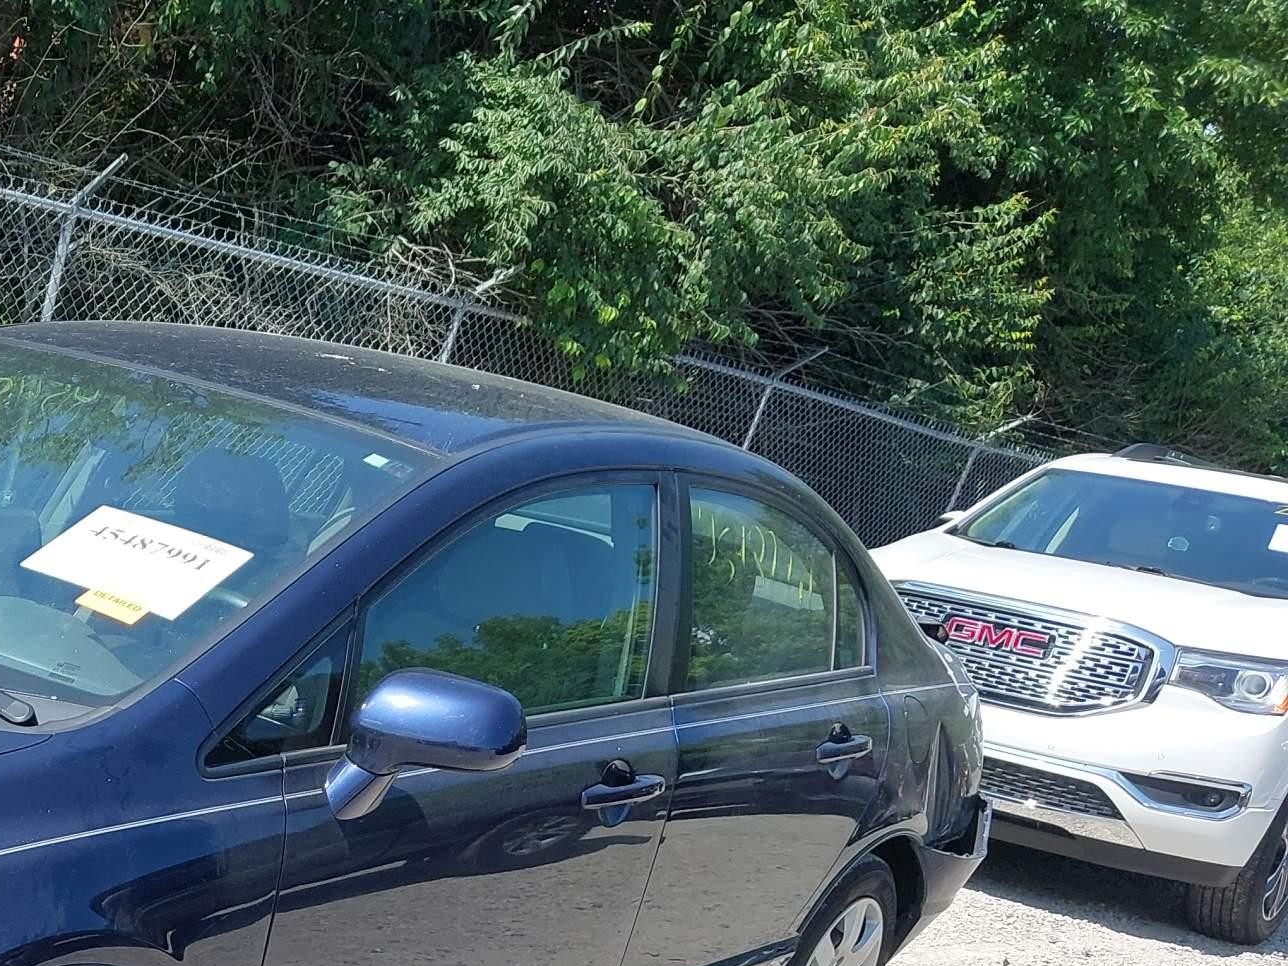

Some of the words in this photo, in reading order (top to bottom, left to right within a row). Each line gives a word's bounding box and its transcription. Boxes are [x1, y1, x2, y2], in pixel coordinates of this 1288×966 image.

[90, 526, 211, 570] 45487991
[93, 589, 143, 613] DETAILED
[946, 616, 1049, 657] GMC
